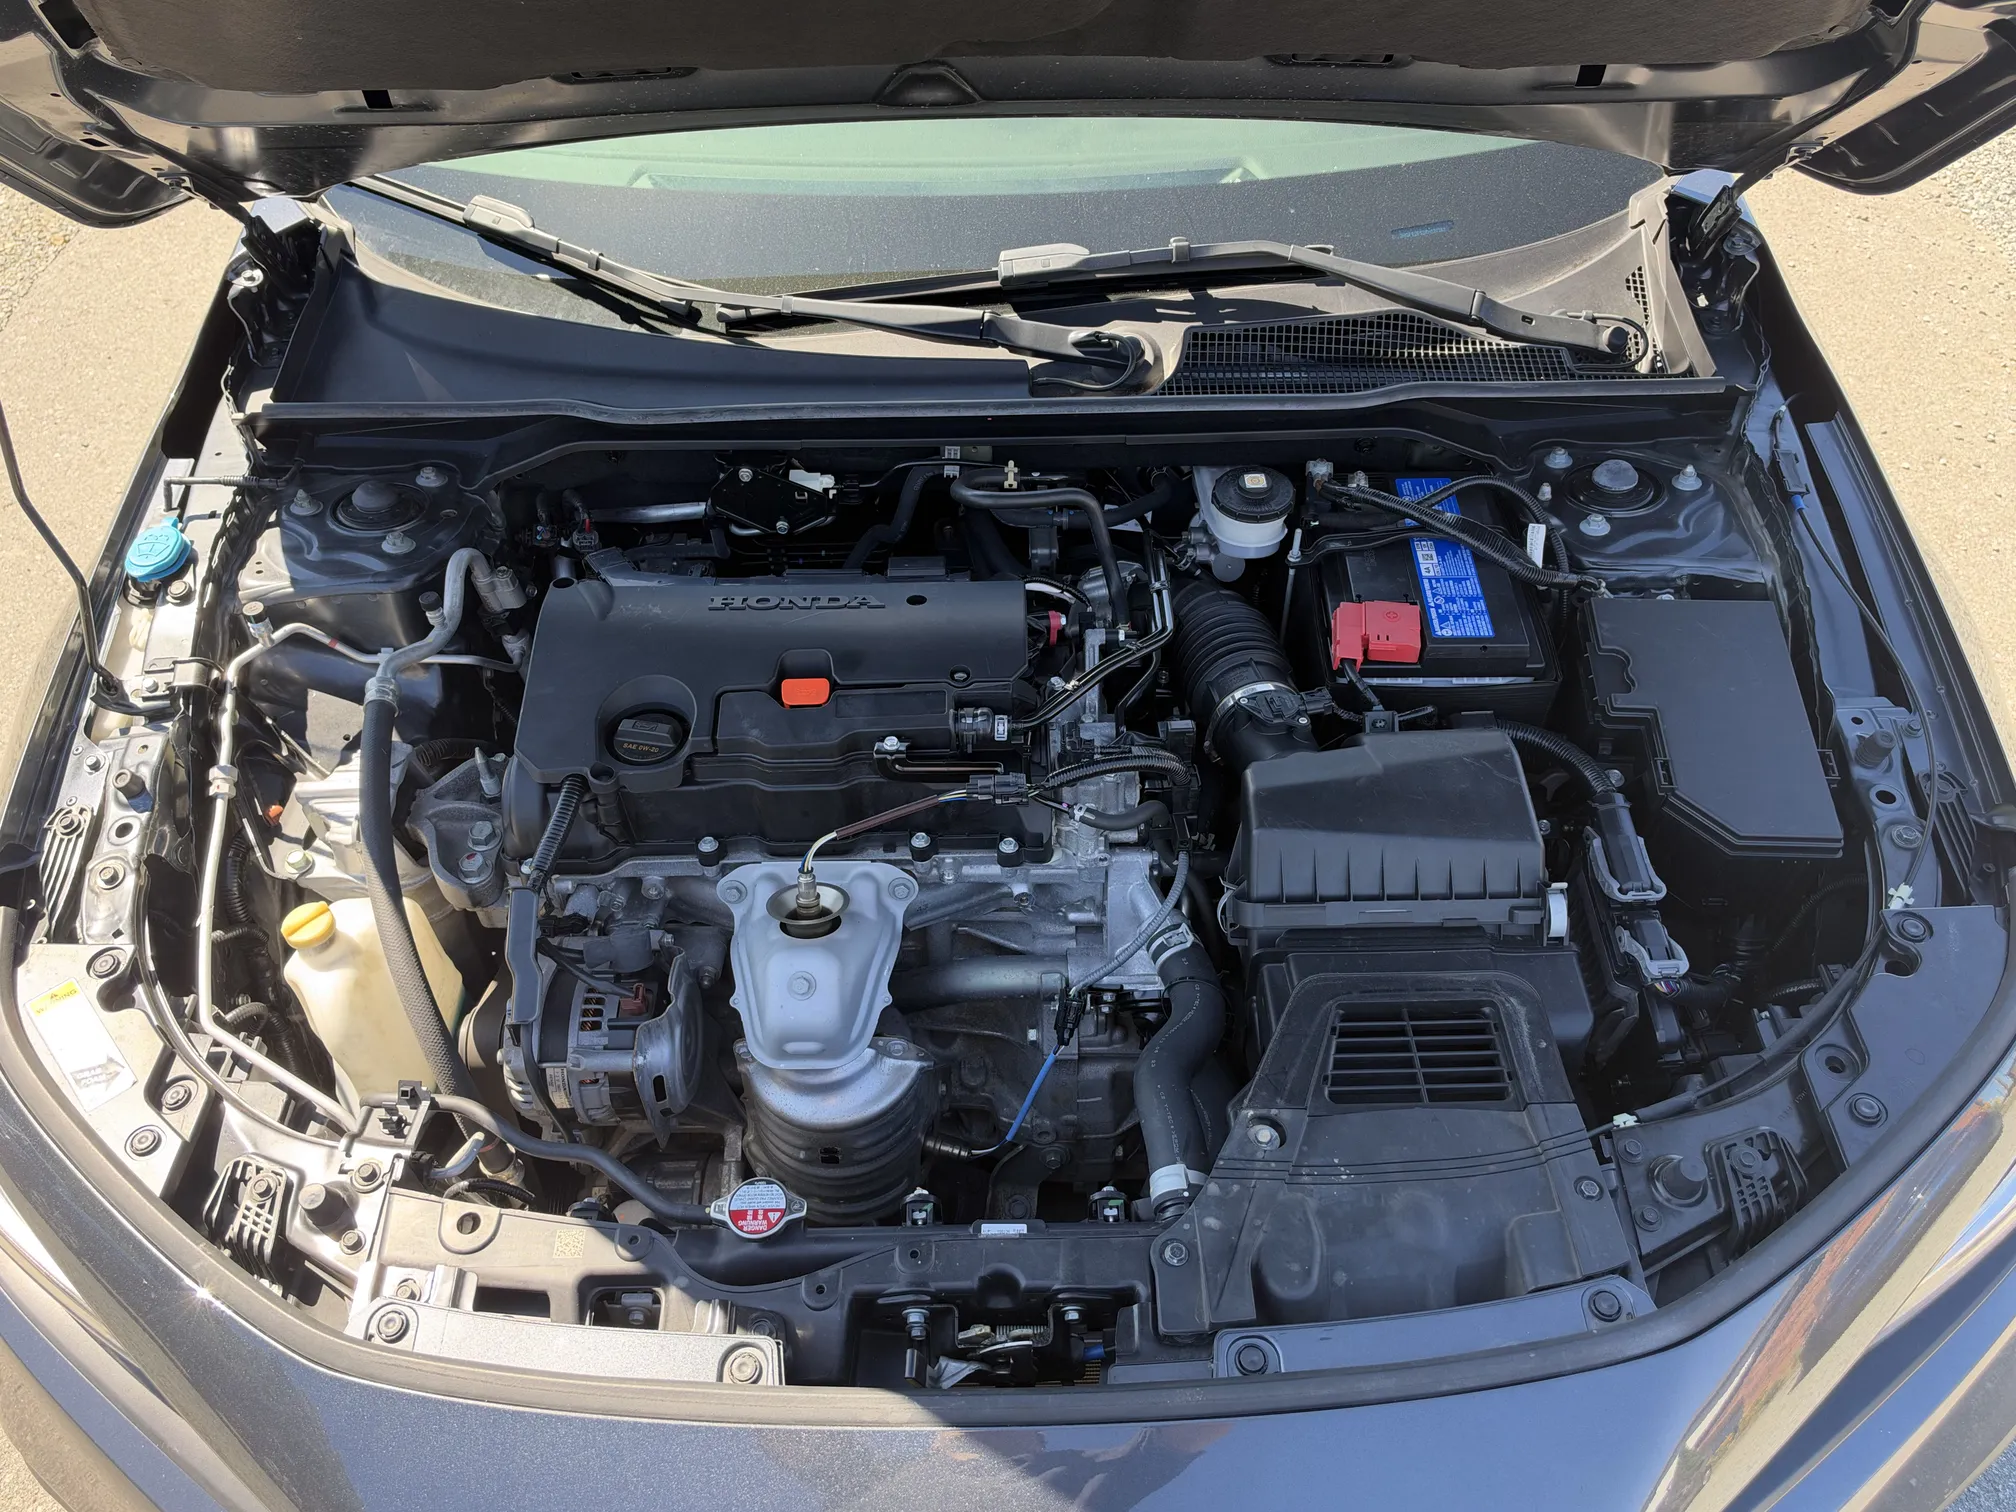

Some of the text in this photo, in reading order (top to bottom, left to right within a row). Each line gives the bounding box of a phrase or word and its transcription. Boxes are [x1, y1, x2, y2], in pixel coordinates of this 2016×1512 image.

[708, 595, 885, 610] HONDA
[639, 745, 659, 753] 0W-20
[36, 989, 77, 1014] WNING
